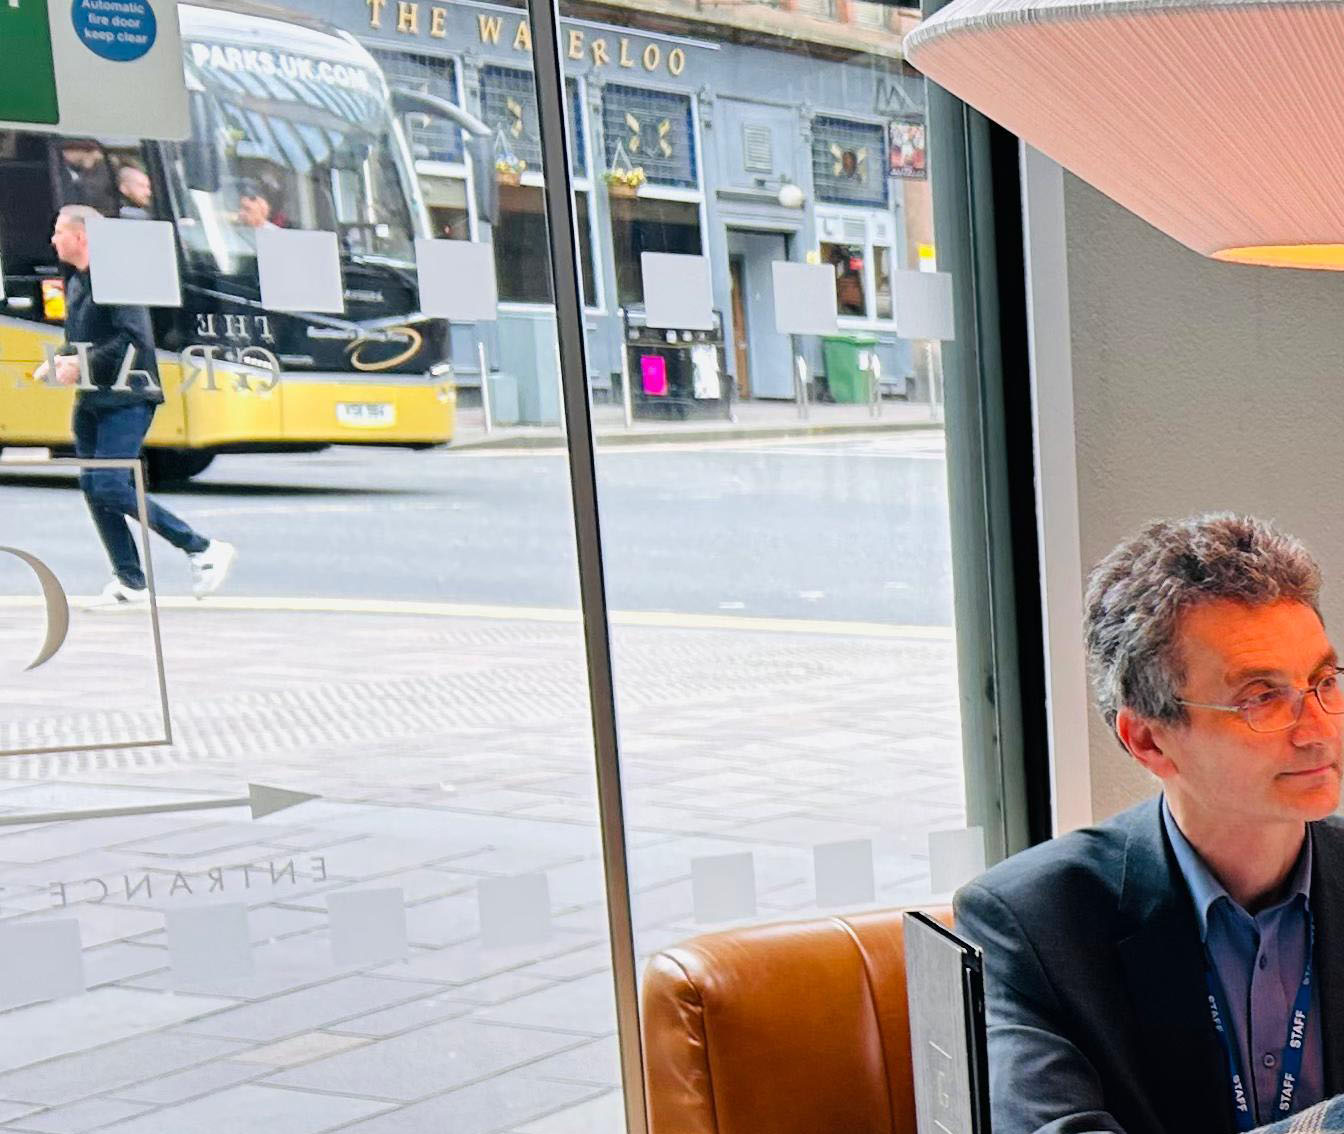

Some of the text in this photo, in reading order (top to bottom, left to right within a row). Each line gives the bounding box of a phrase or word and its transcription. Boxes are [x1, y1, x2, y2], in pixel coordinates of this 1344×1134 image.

[84, 27, 149, 44] keep clear
[111, 16, 142, 28] door
[366, 0, 685, 76] THE WAERLOO
[1290, 1010, 1306, 1049] STAFF
[1233, 1074, 1248, 1112] STAFF
[1279, 1073, 1296, 1111] STAFF
